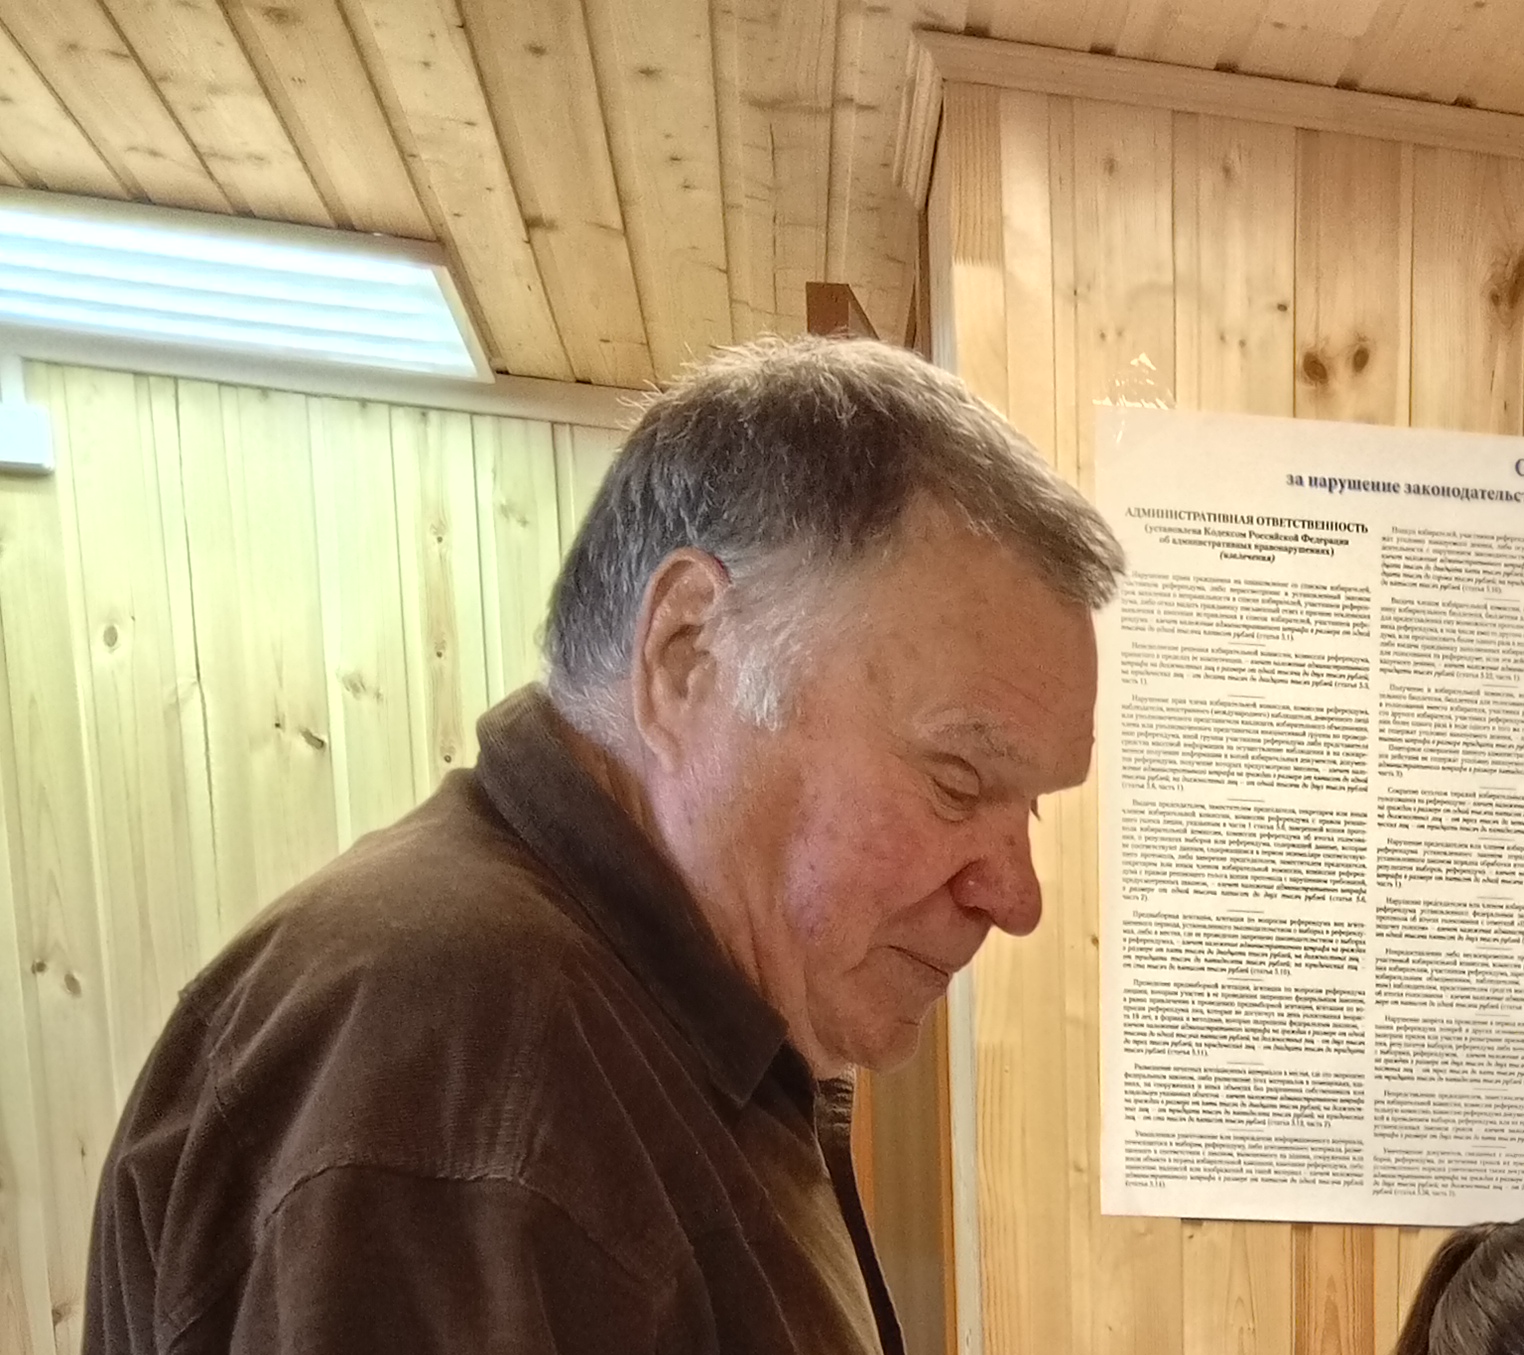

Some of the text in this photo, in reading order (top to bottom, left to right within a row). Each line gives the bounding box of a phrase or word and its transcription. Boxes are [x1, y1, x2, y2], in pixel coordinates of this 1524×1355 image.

[1286, 474, 1304, 487] за
[1309, 476, 1399, 495] нарушение
[1125, 507, 1369, 534] АДМИНИСТРАТИВНАЯ ОТВЕТСТВЕННОСТЬ
